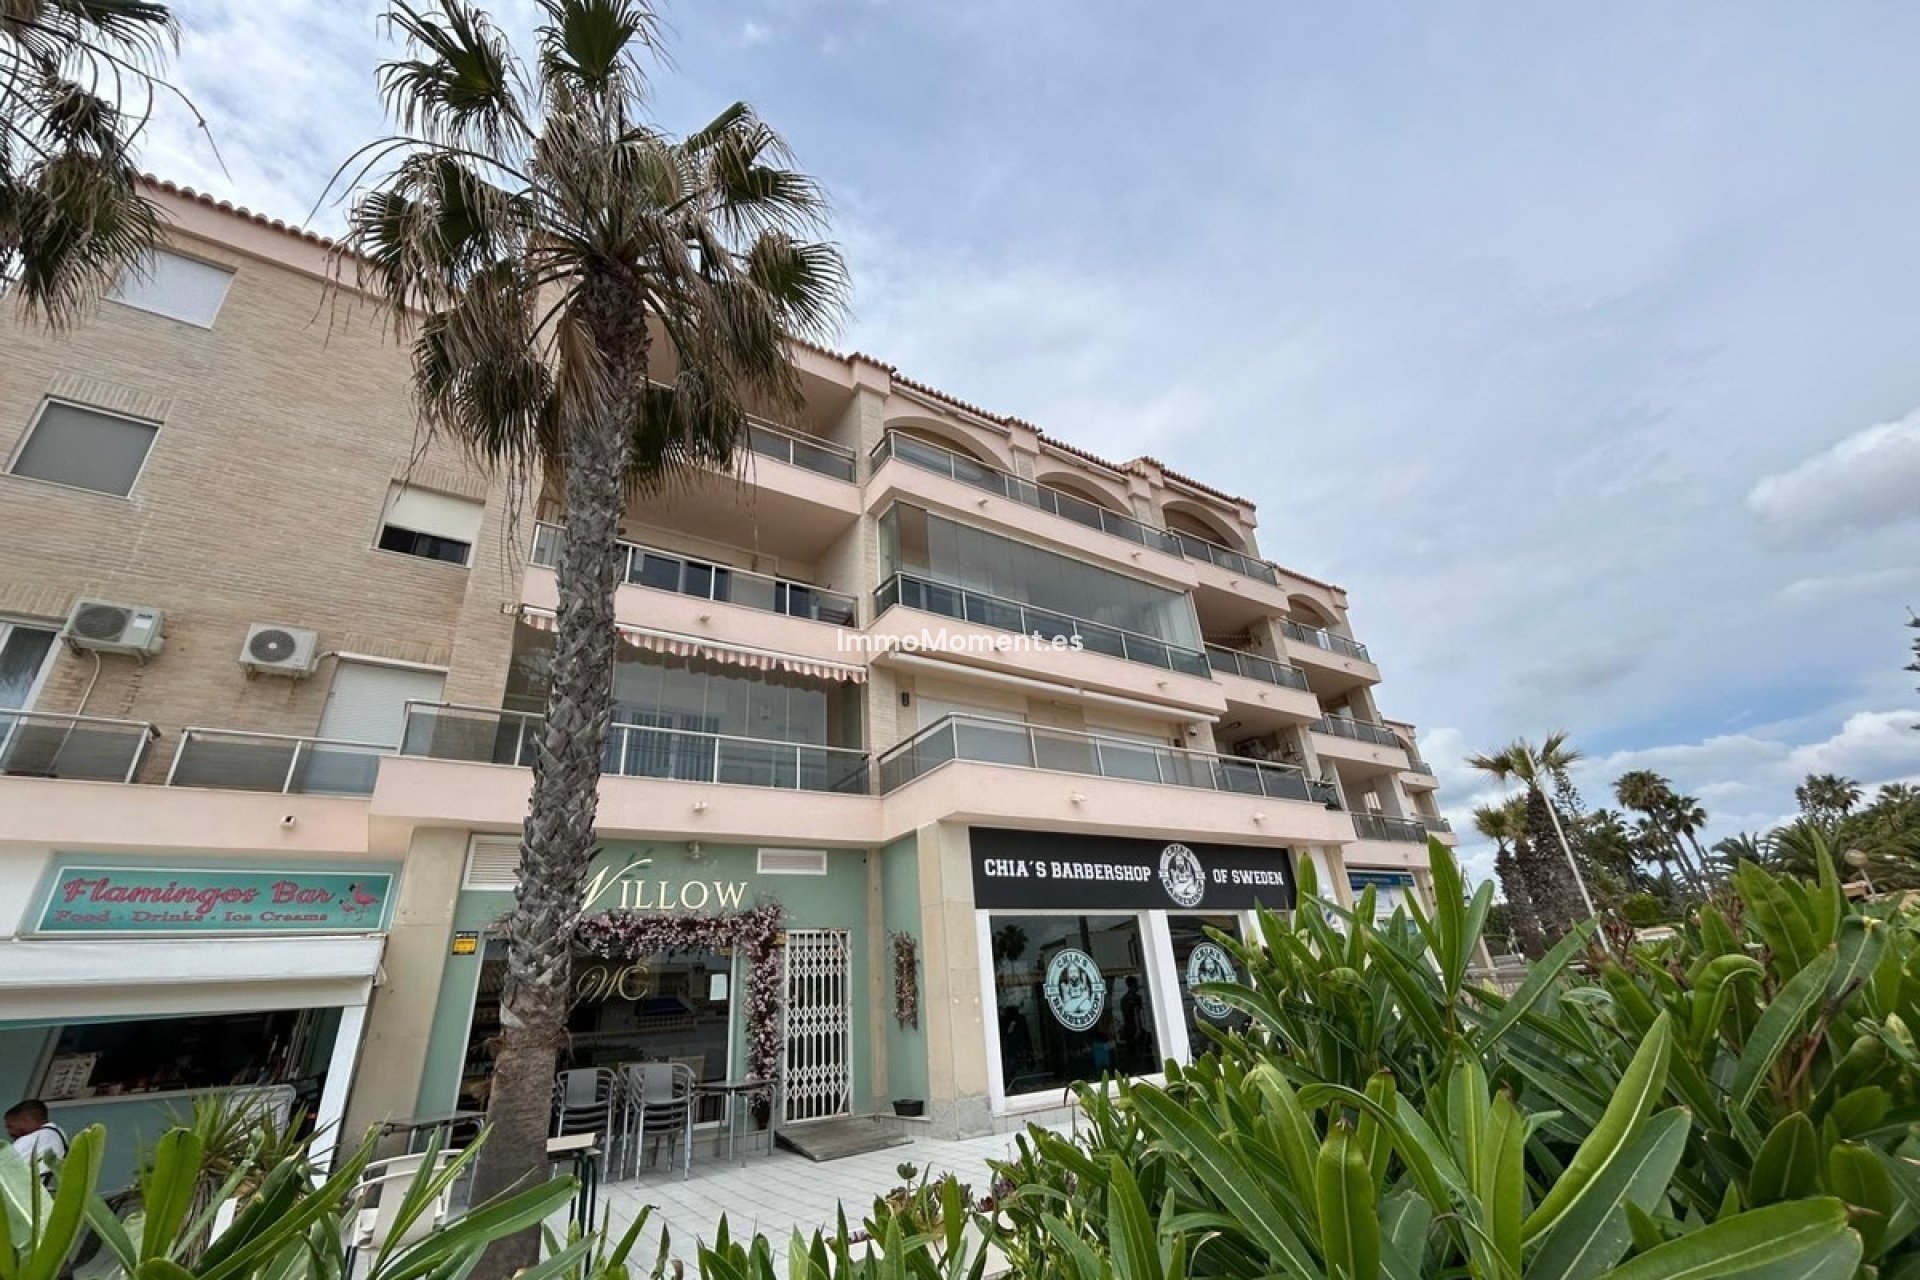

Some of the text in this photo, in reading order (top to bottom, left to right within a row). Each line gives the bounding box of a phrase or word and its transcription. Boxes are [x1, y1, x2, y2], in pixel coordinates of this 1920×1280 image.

[983, 858, 1151, 882] CHIA'S BARBERSHOP
[1212, 868, 1284, 886] OF SWEDEN
[63, 877, 336, 915] Flamingos Bar
[55, 910, 328, 923] Food Drinks Ice Creams
